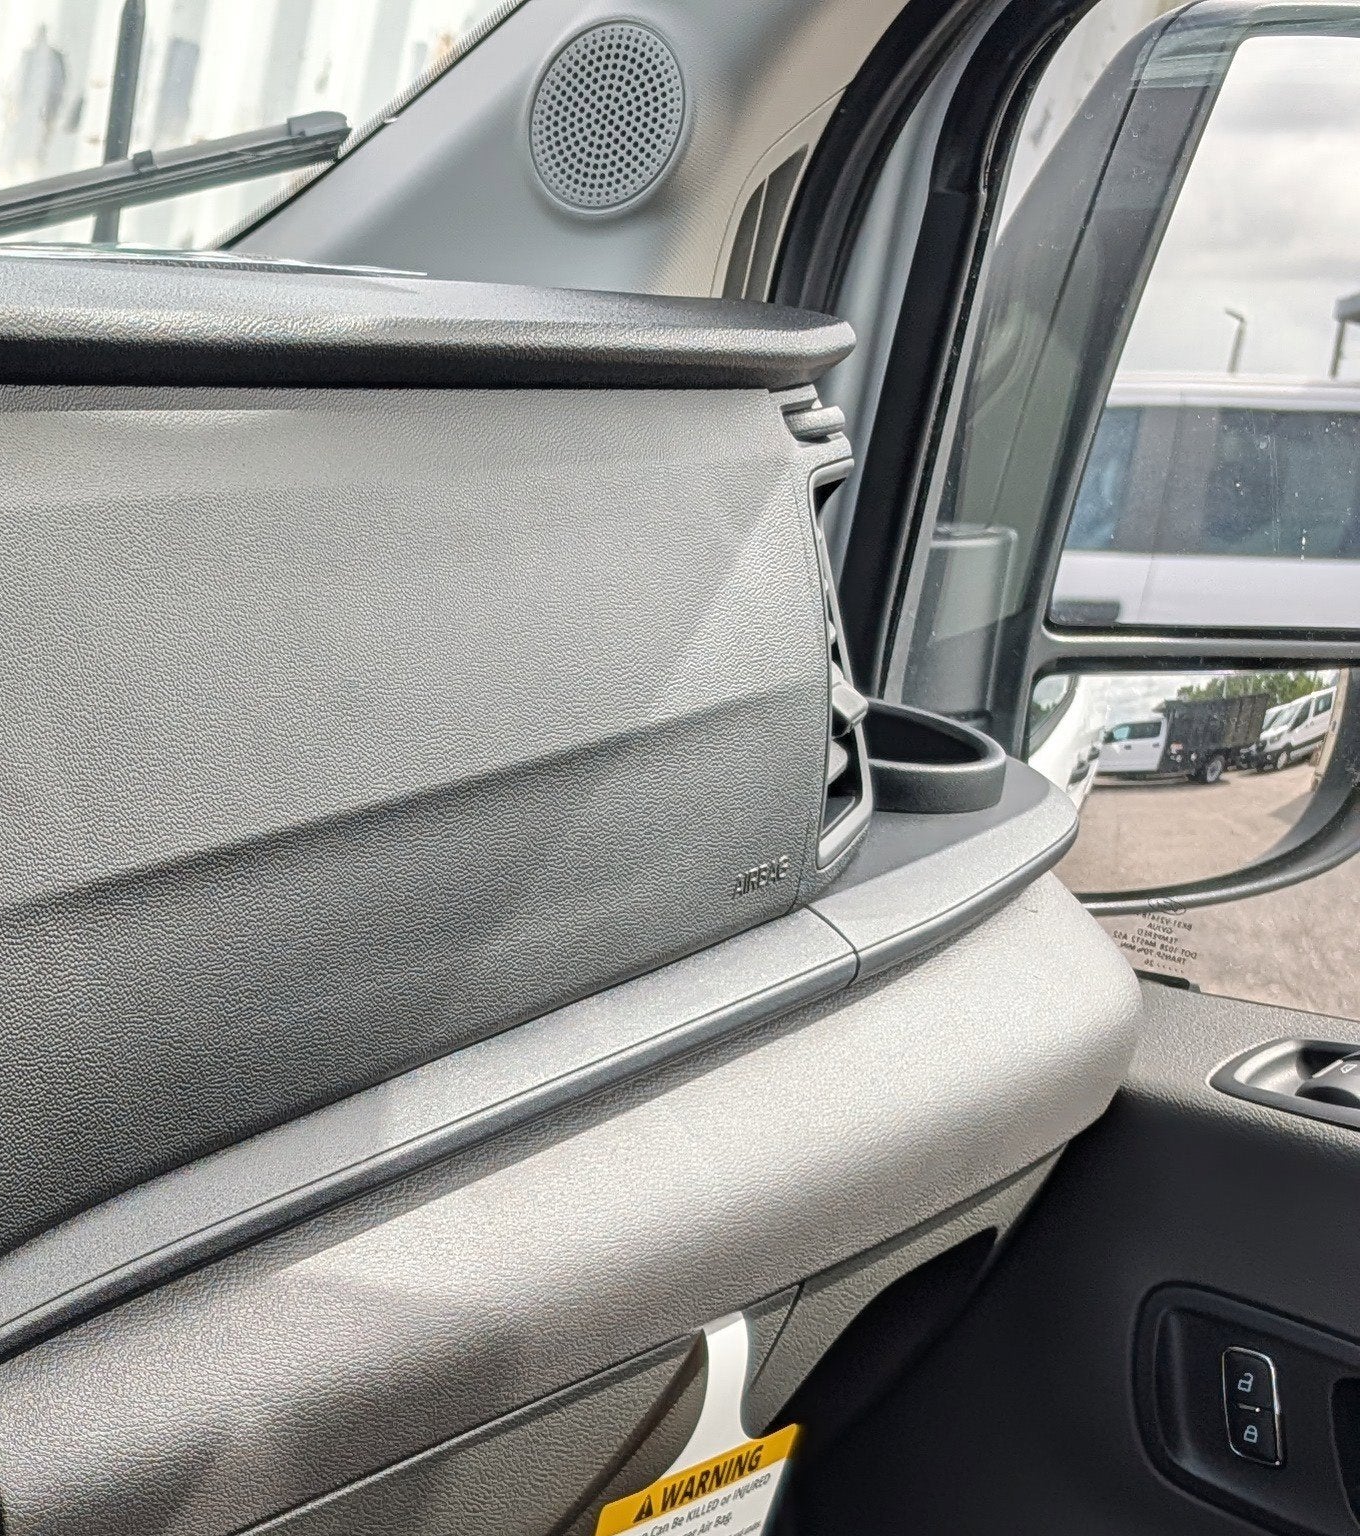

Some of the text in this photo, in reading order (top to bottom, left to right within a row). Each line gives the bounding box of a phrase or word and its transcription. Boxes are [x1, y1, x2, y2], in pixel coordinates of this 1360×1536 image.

[660, 1444, 764, 1512] WARNING
[671, 1516, 684, 1530] Be
[685, 1498, 720, 1524] KILLED
[732, 1472, 771, 1501] INJURED
[697, 1520, 714, 1536] Air
